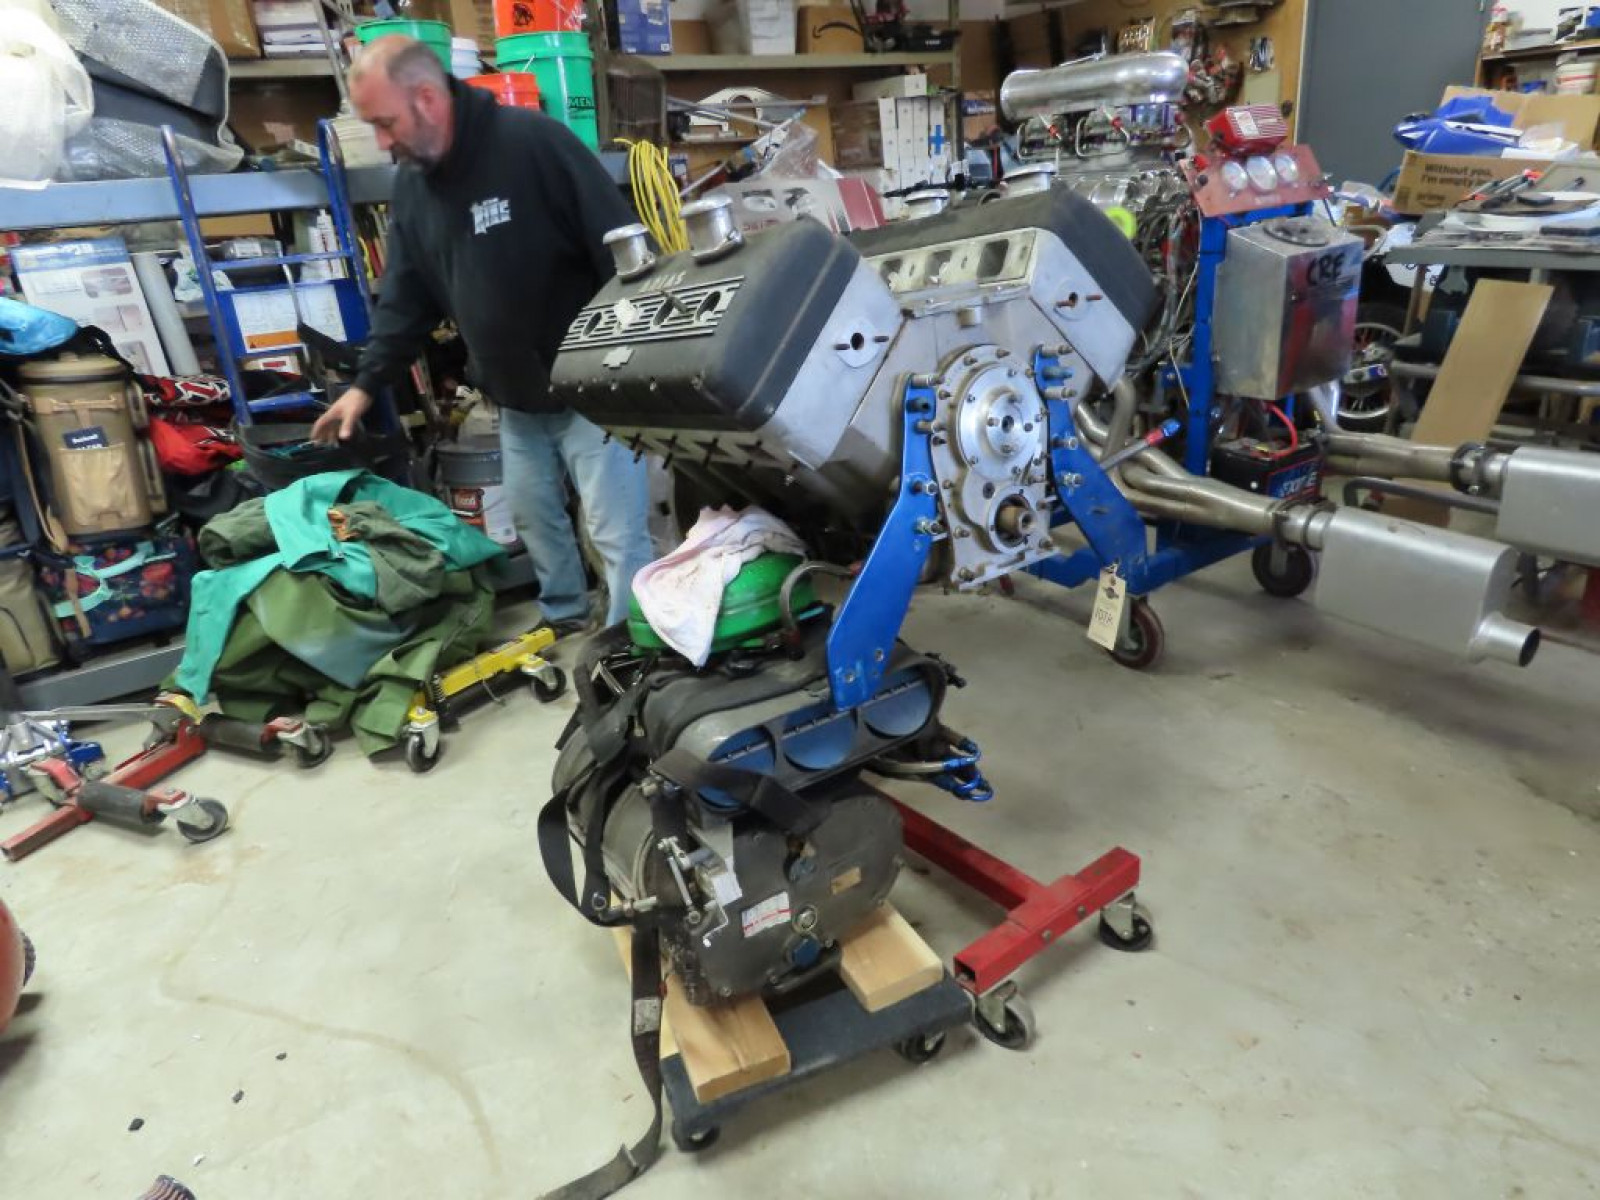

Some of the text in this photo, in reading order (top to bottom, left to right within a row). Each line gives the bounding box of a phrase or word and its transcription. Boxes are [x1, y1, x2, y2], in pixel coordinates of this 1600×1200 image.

[1425, 164, 1468, 176] Without
[1440, 177, 1472, 188] empty
[1306, 252, 1346, 286] CRE
